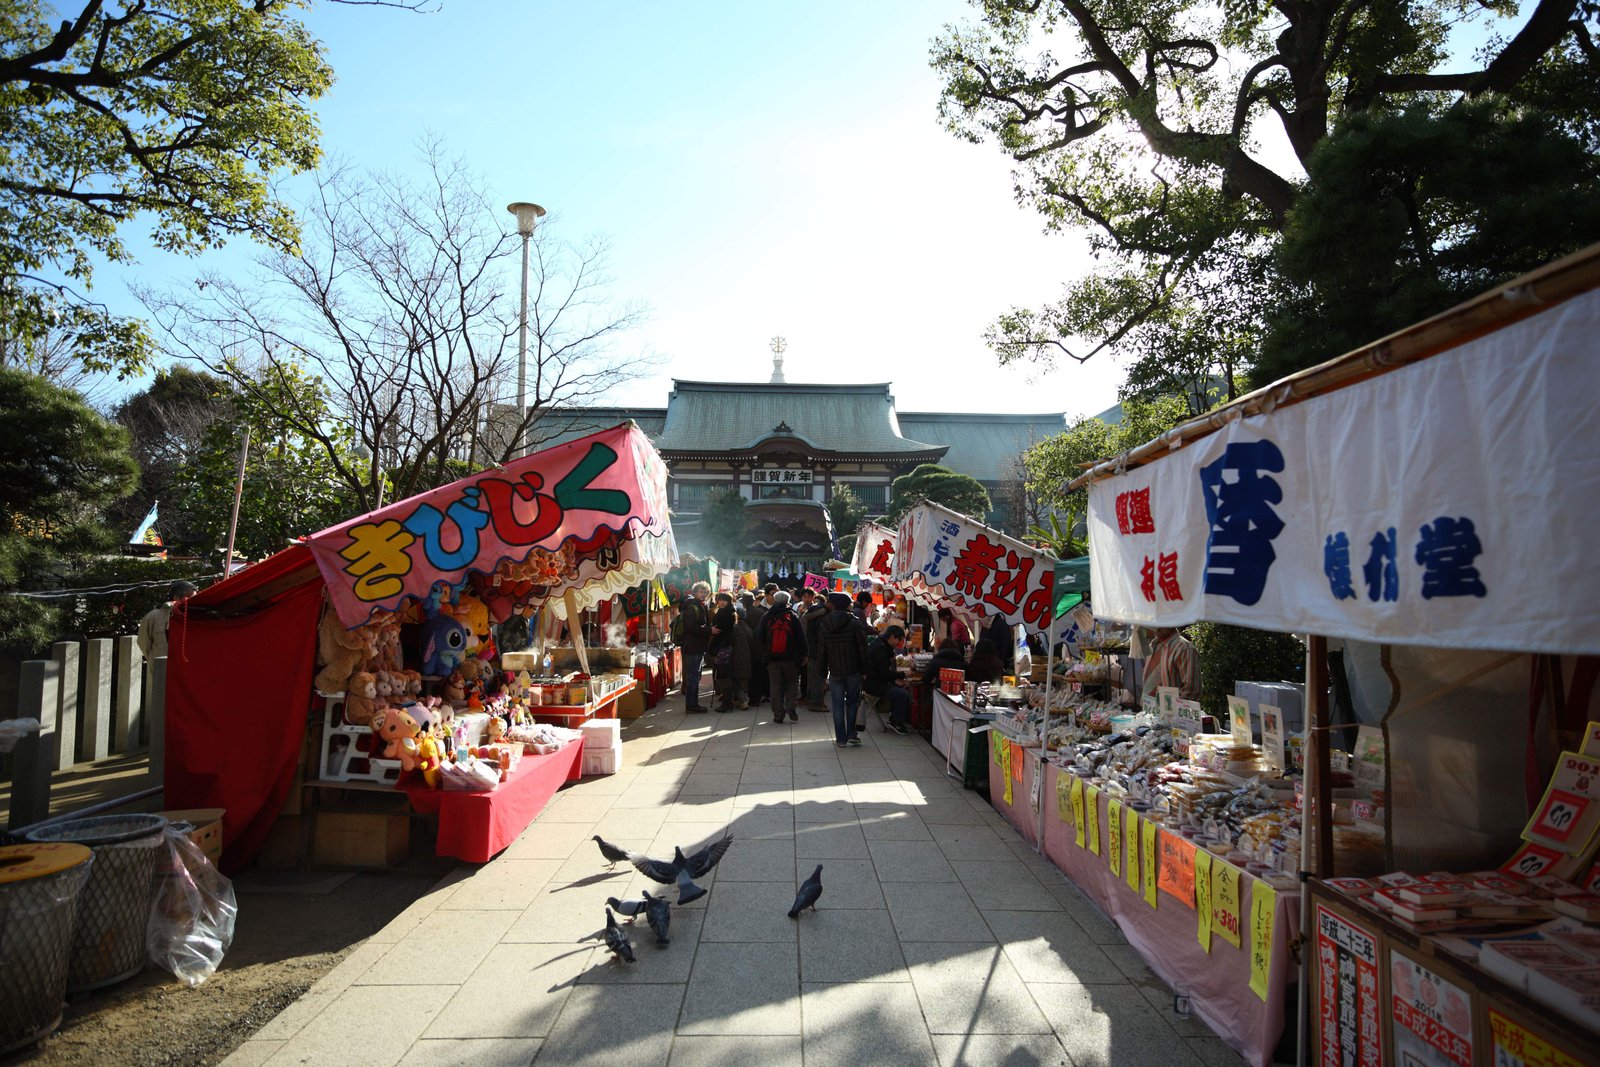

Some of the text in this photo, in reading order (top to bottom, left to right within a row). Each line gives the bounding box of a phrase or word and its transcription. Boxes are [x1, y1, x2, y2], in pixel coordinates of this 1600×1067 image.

[754, 471, 811, 482] 謹賀新年
[946, 534, 1054, 630] 煮込み
[1566, 759, 1600, 775] 201
[1213, 909, 1238, 935] ¥380
[1320, 913, 1375, 961] 平成二十三年
[1321, 941, 1340, 1067] 神宮館九星本
[1415, 1000, 1443, 1023] 2011年
[1395, 1002, 1471, 1065] 平成23年
